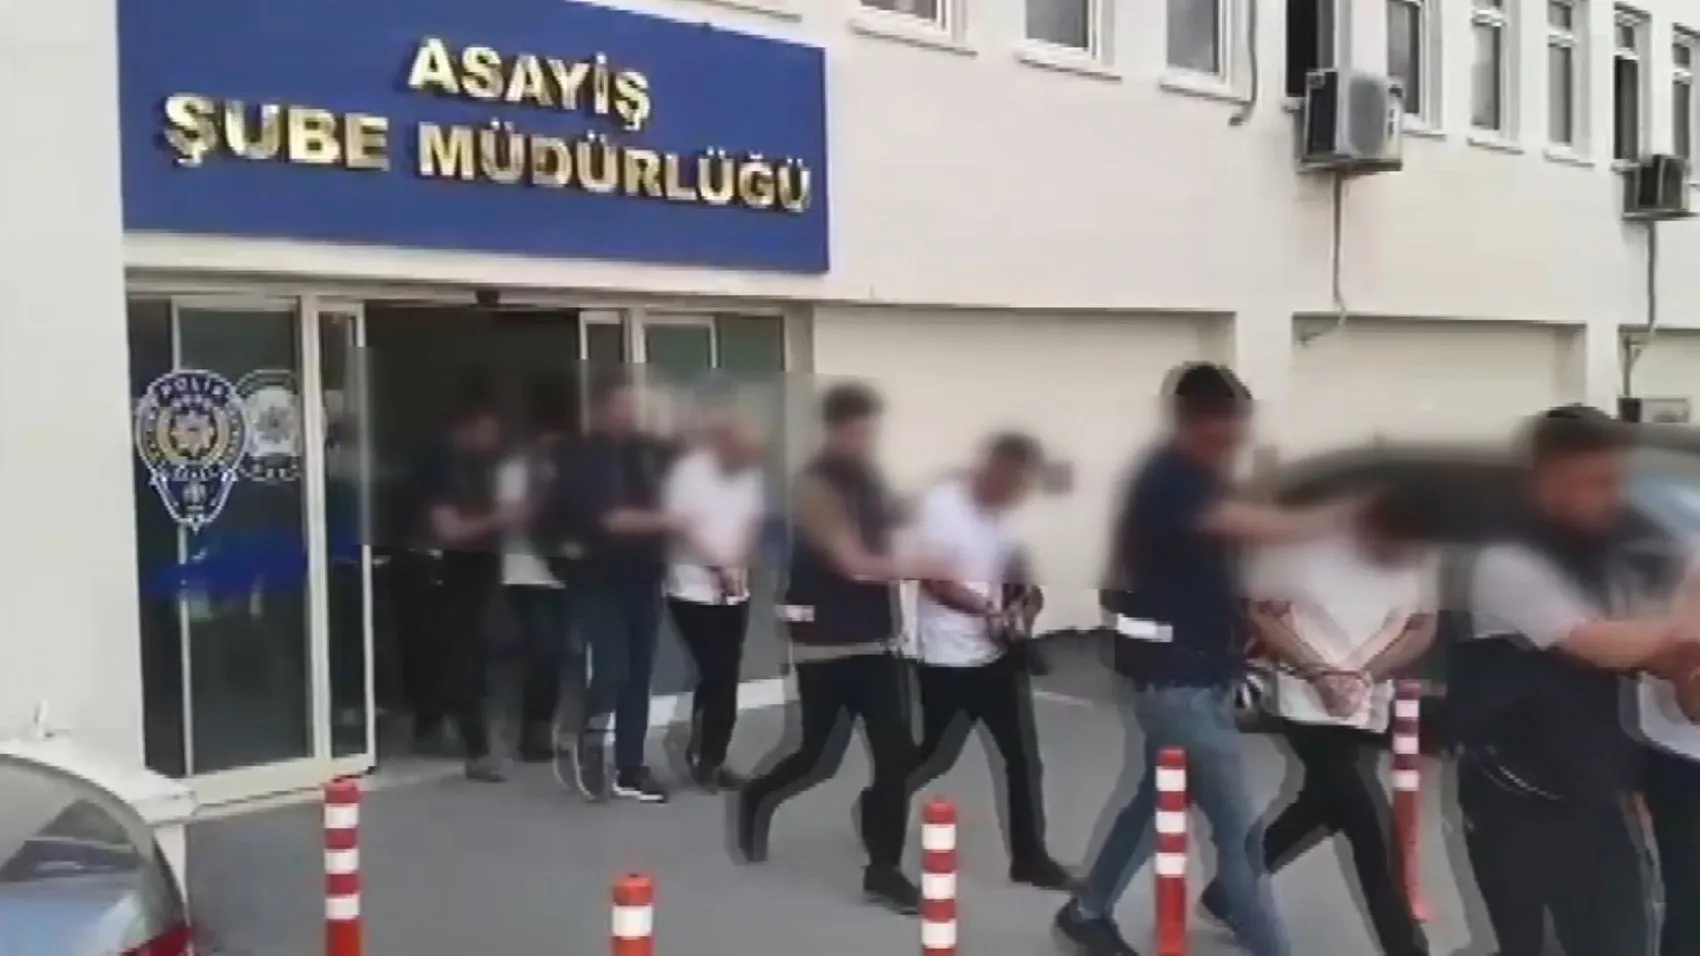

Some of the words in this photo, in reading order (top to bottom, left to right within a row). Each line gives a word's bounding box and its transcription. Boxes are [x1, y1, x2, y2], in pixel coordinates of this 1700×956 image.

[407, 36, 651, 131] ASAYİŞ
[164, 93, 390, 170] ŞUBE
[417, 117, 812, 213] MÜDÜRLÜĞÜ
